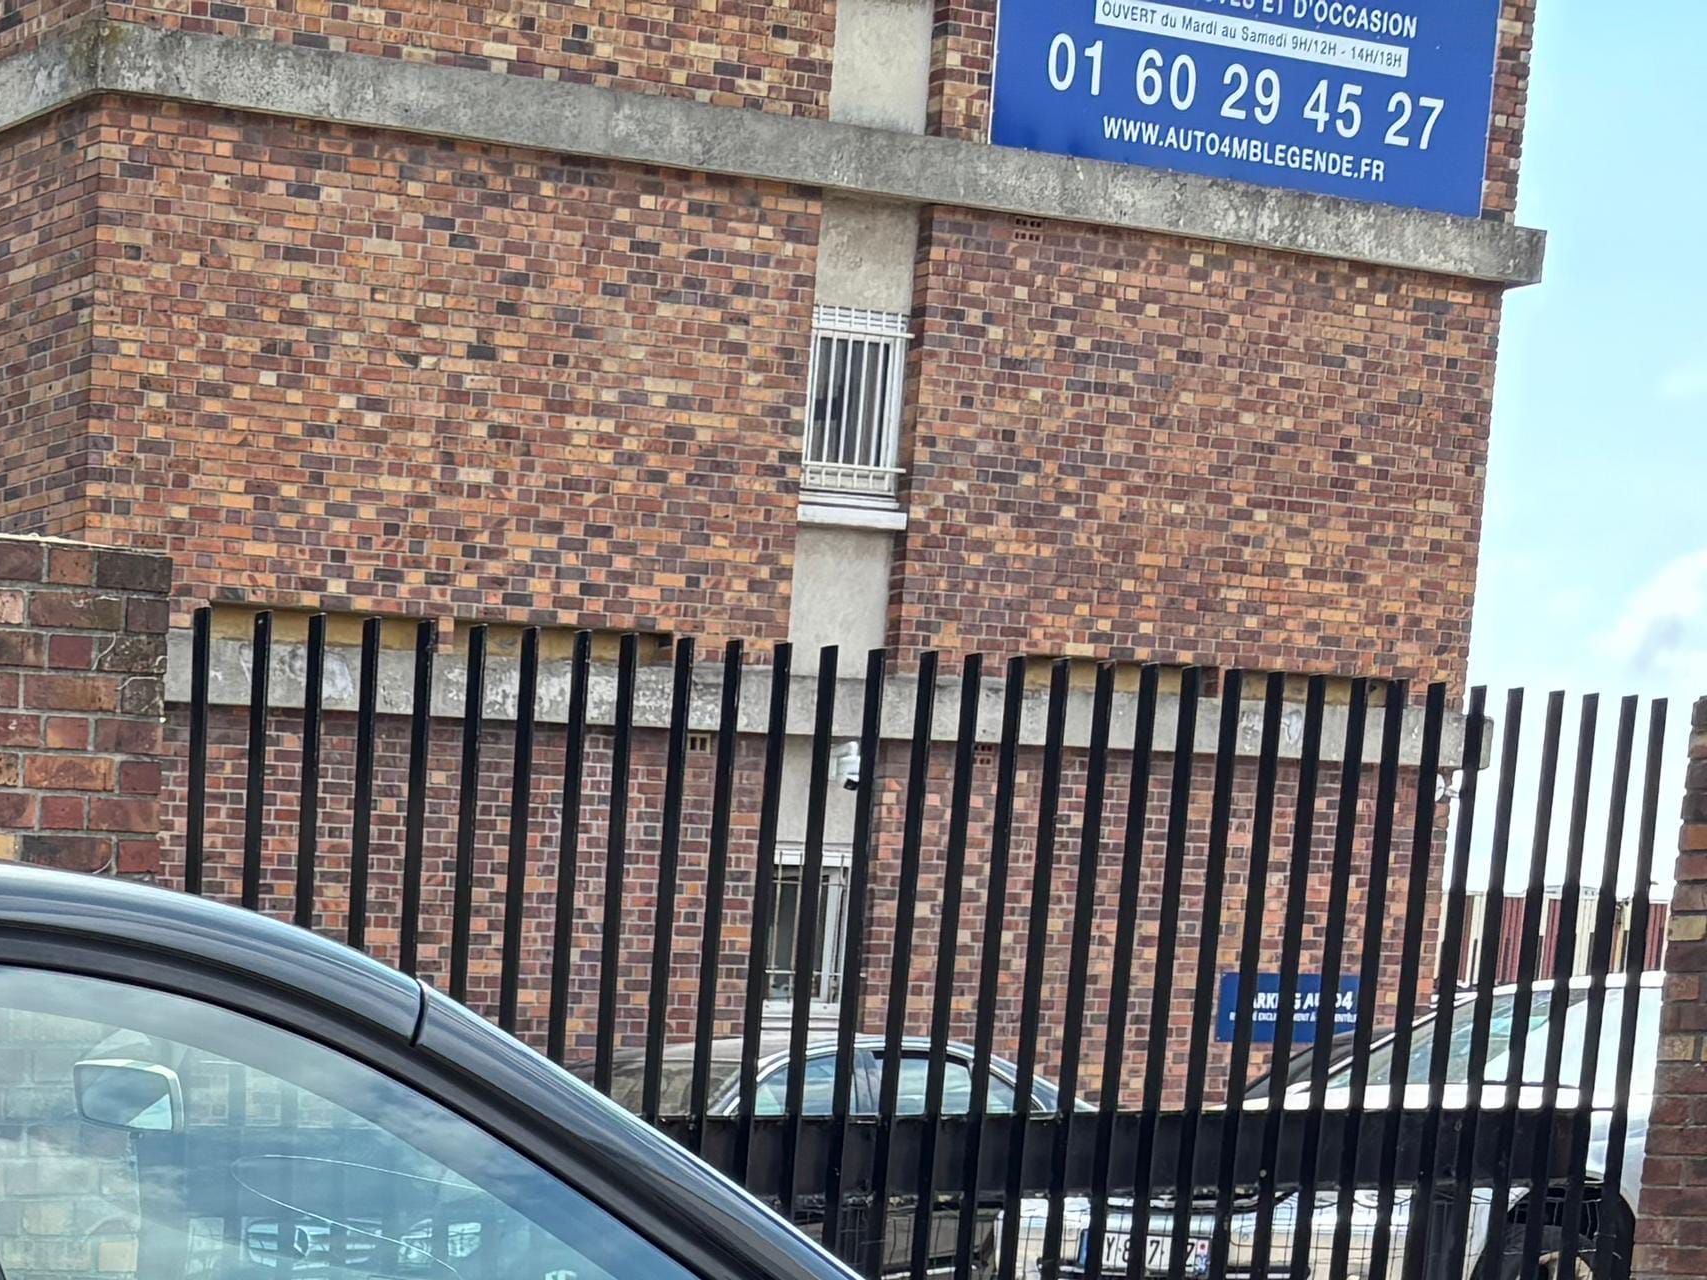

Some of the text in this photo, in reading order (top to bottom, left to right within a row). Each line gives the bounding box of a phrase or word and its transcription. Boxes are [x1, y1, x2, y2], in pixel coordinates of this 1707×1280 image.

[1102, 4, 1156, 26] OUVERT
[1161, 14, 1177, 29] du
[1181, 15, 1217, 35] Mardi
[1222, 25, 1237, 39] au
[1241, 25, 1287, 48] Samedi
[1291, 35, 1337, 57] 9H/12H
[1351, 46, 1403, 68] 14H/18H
[1293, 0, 1418, 38] D'OCCASION
[1047, 32, 1445, 150] 01 60 29 45 27
[1102, 116, 1385, 182] WWW.AUTO4MBLEGENDE.FR
